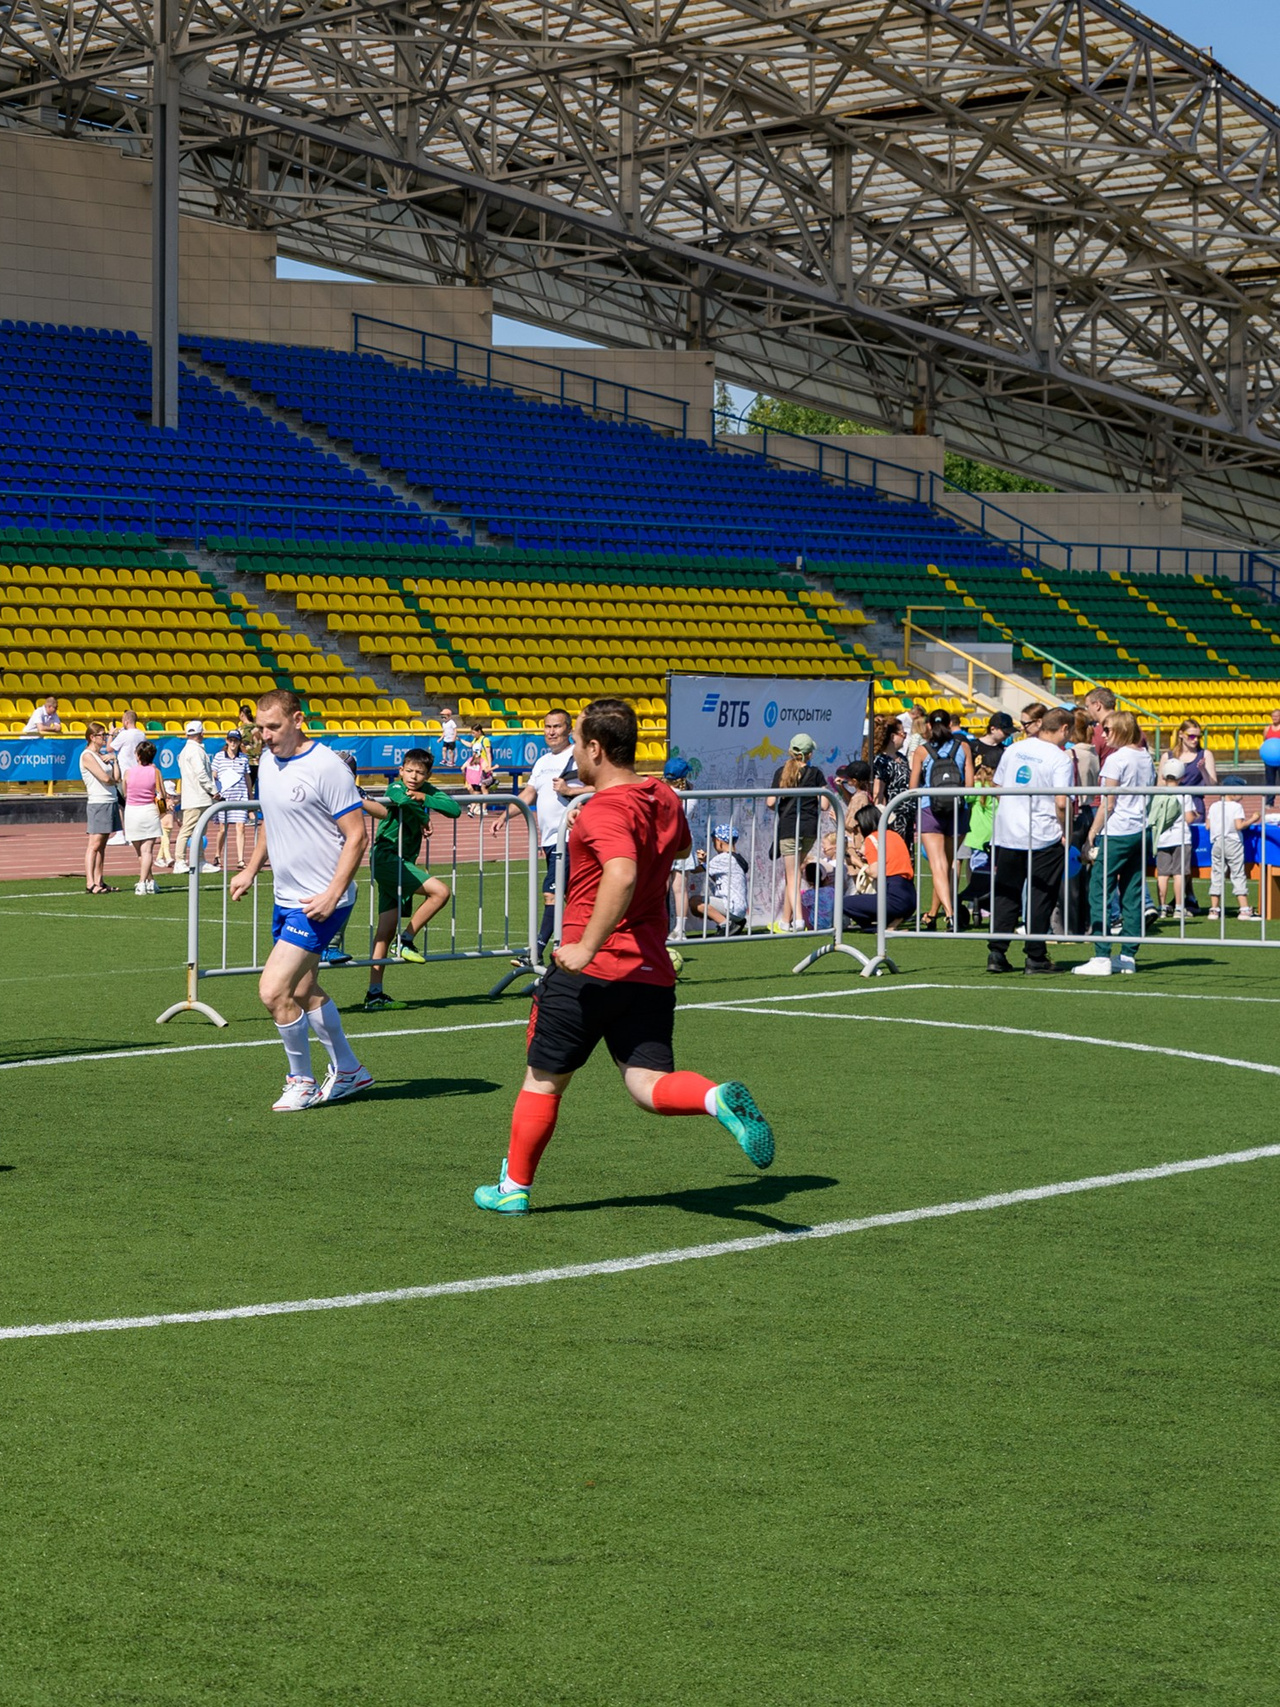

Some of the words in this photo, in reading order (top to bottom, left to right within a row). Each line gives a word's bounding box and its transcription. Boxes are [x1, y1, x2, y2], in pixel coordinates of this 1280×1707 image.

[718, 701, 750, 728] ВТБ
[780, 708, 832, 725] открытие
[13, 754, 66, 768] открытие
